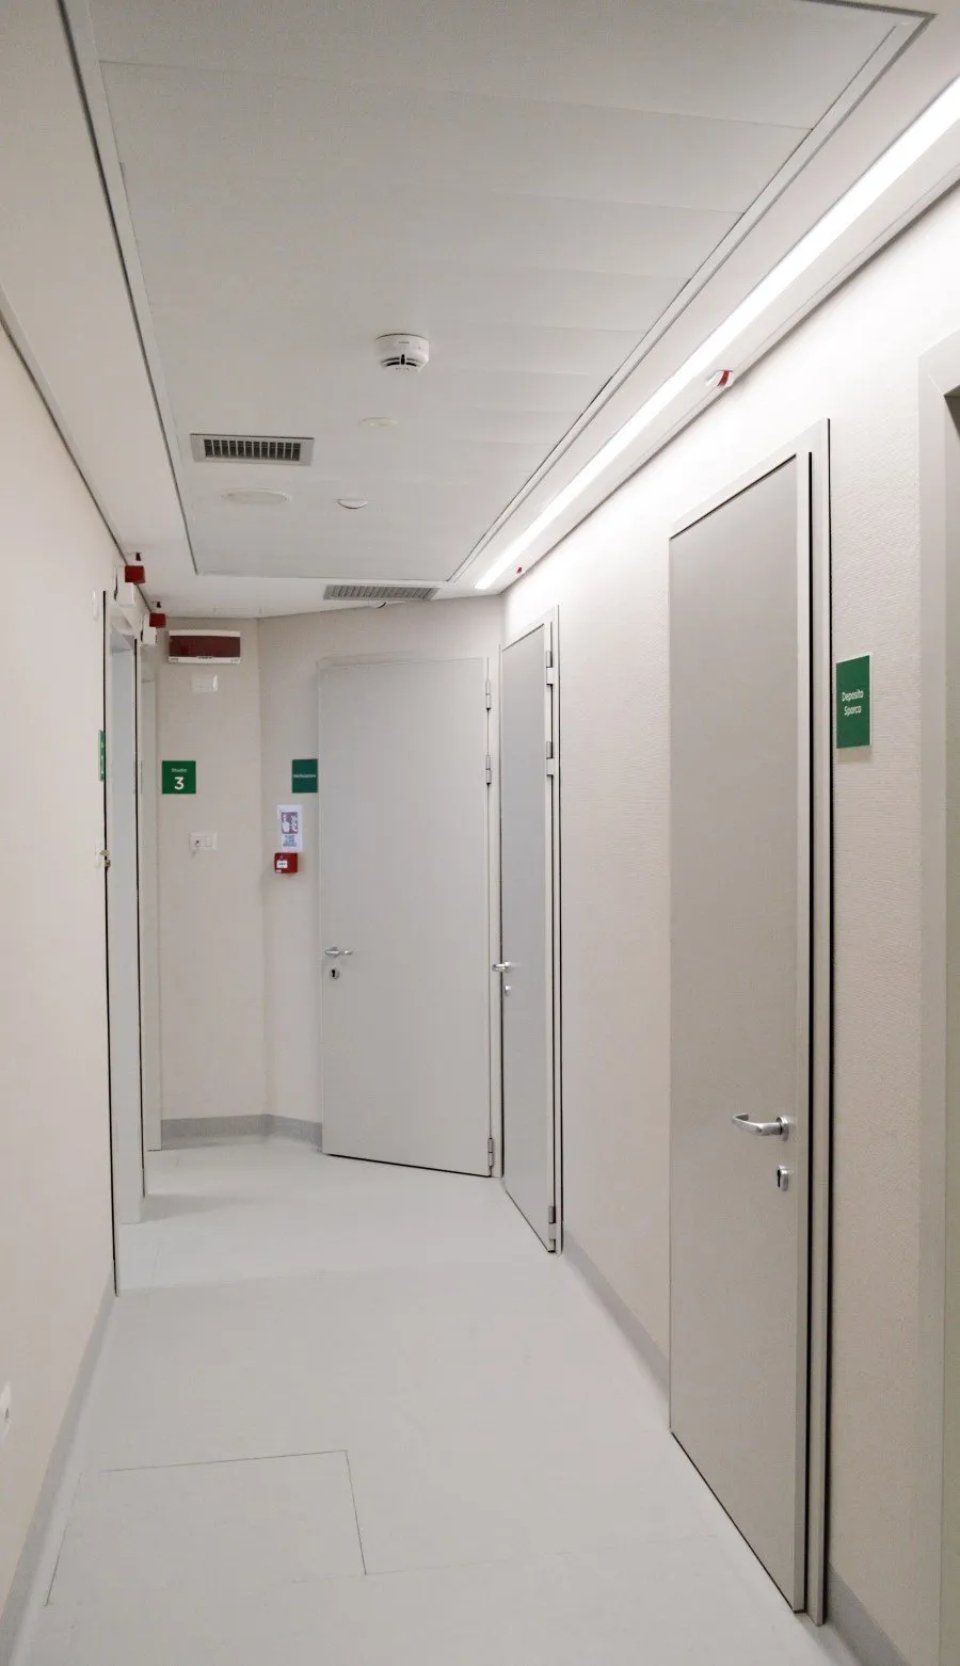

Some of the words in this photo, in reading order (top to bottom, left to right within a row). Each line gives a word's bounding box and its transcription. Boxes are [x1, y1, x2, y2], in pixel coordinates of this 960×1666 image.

[842, 689, 864, 702] Deposito
[844, 705, 862, 717] Sporco
[174, 776, 184, 791] 3
